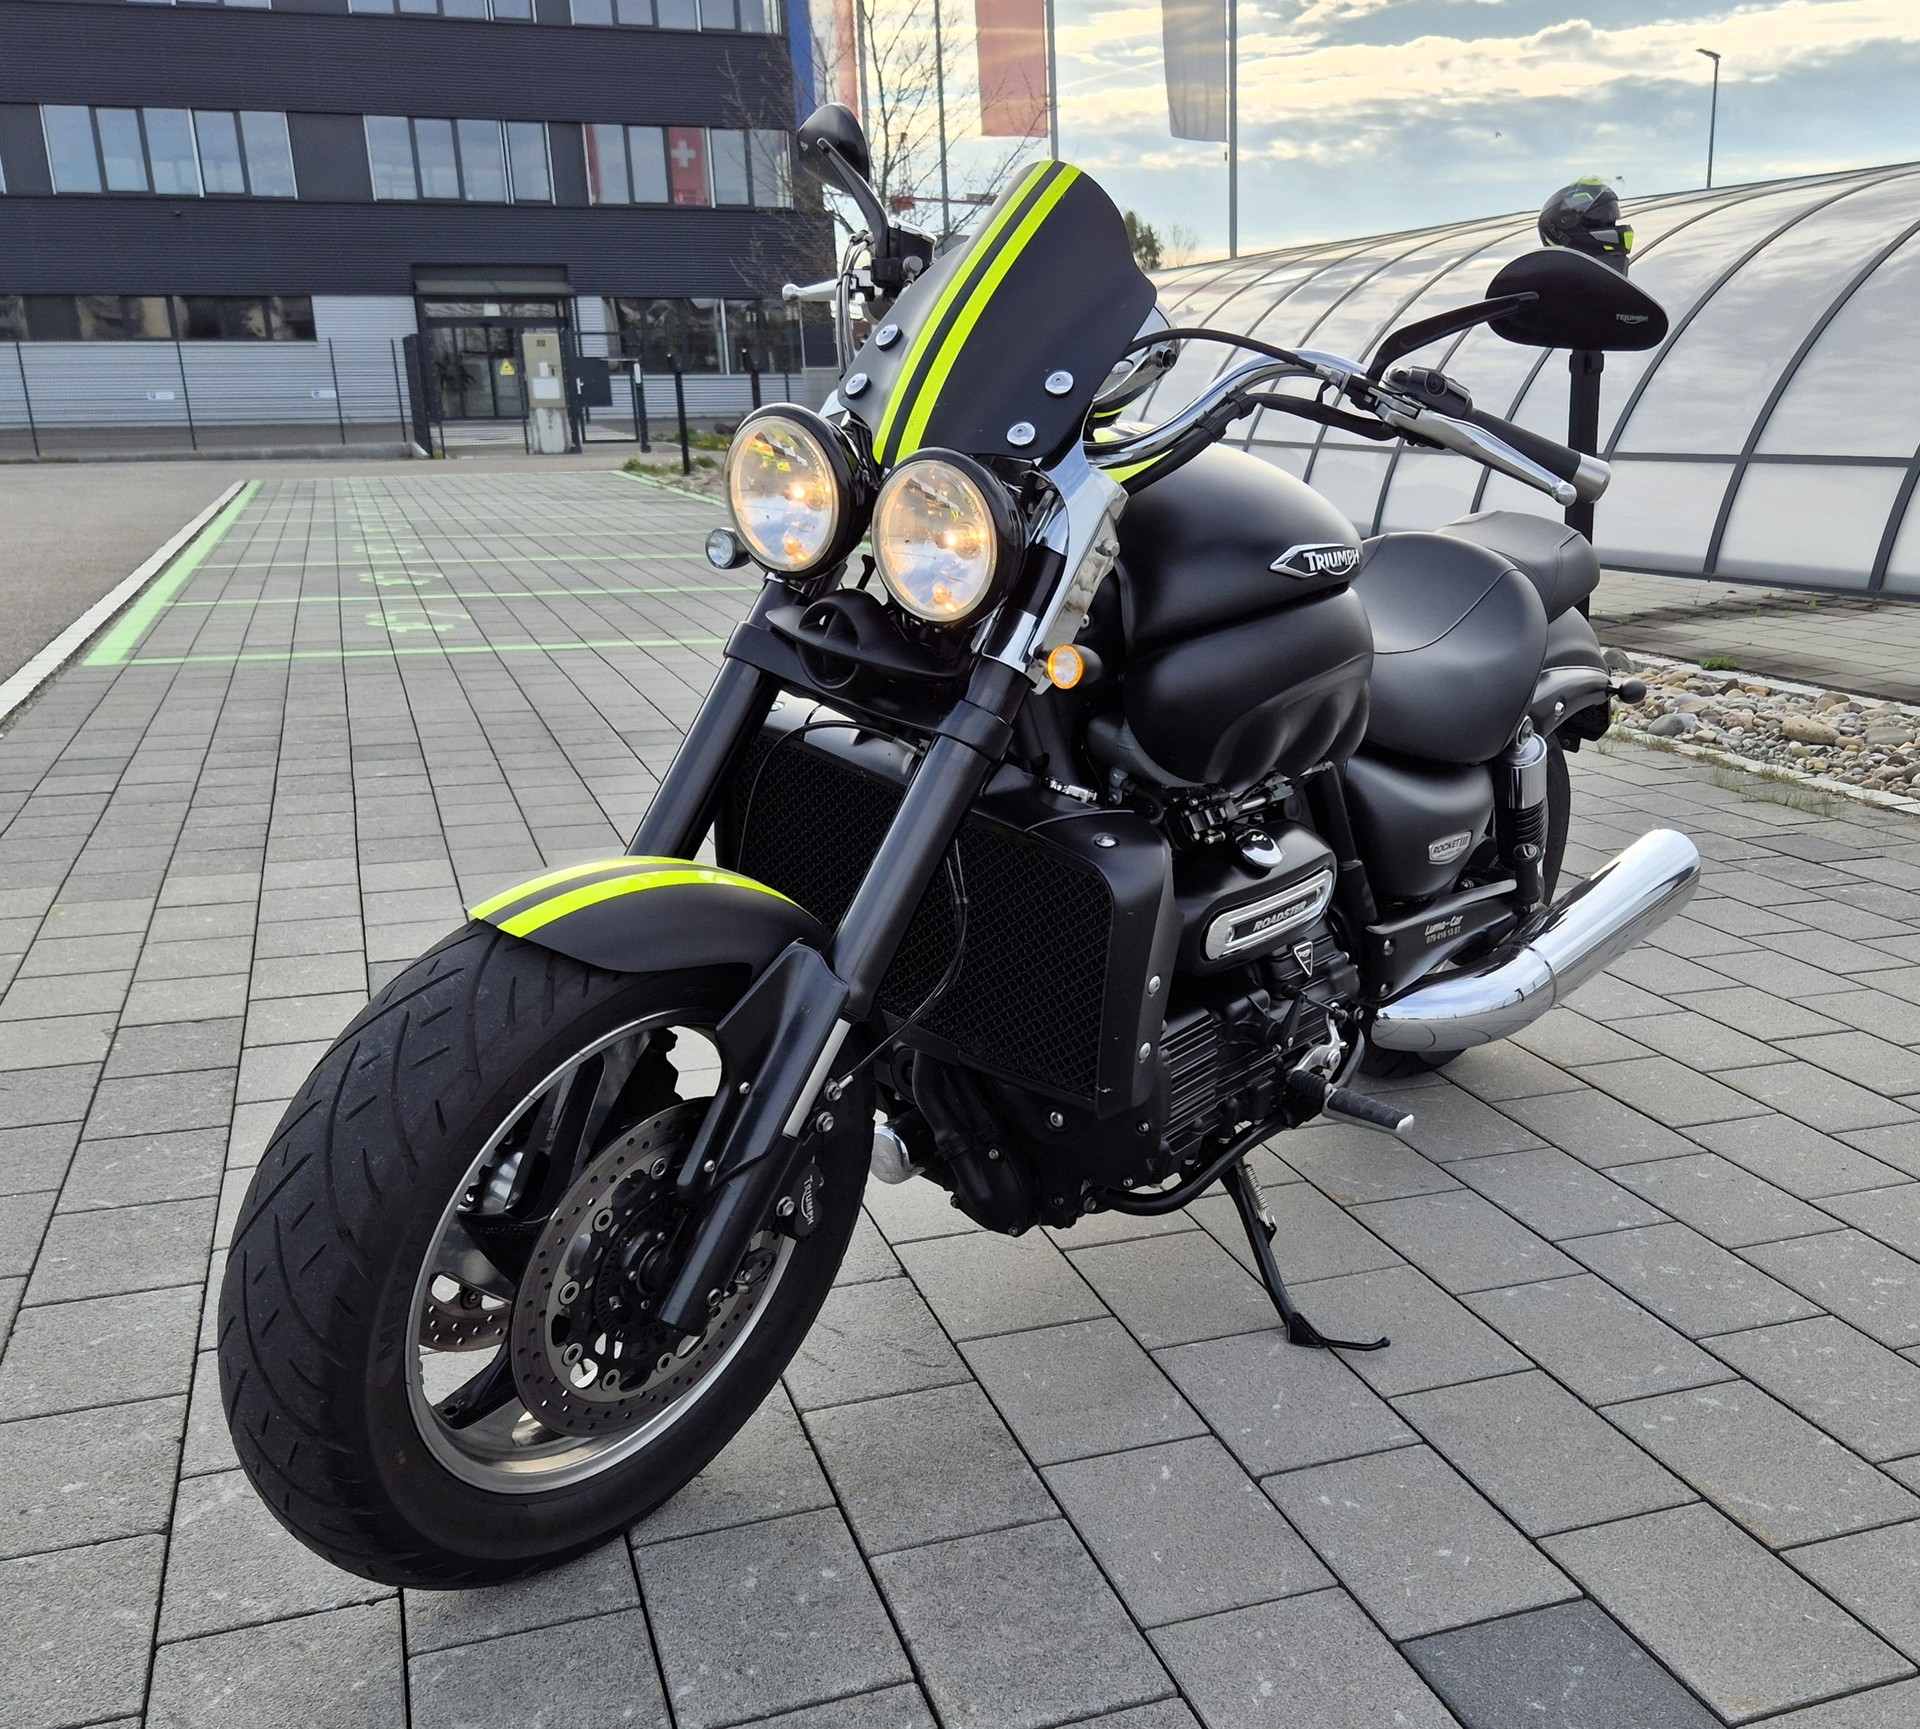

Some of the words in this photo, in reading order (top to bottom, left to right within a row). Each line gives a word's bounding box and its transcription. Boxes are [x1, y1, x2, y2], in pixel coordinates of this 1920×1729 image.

[1615, 313, 1649, 324] TRIUMPH
[1303, 548, 1360, 575] TRIUMPH
[1433, 838, 1461, 854] ROCKET
[1252, 900, 1307, 932] ROADSTER
[801, 1174, 815, 1226] TRIUMPH
